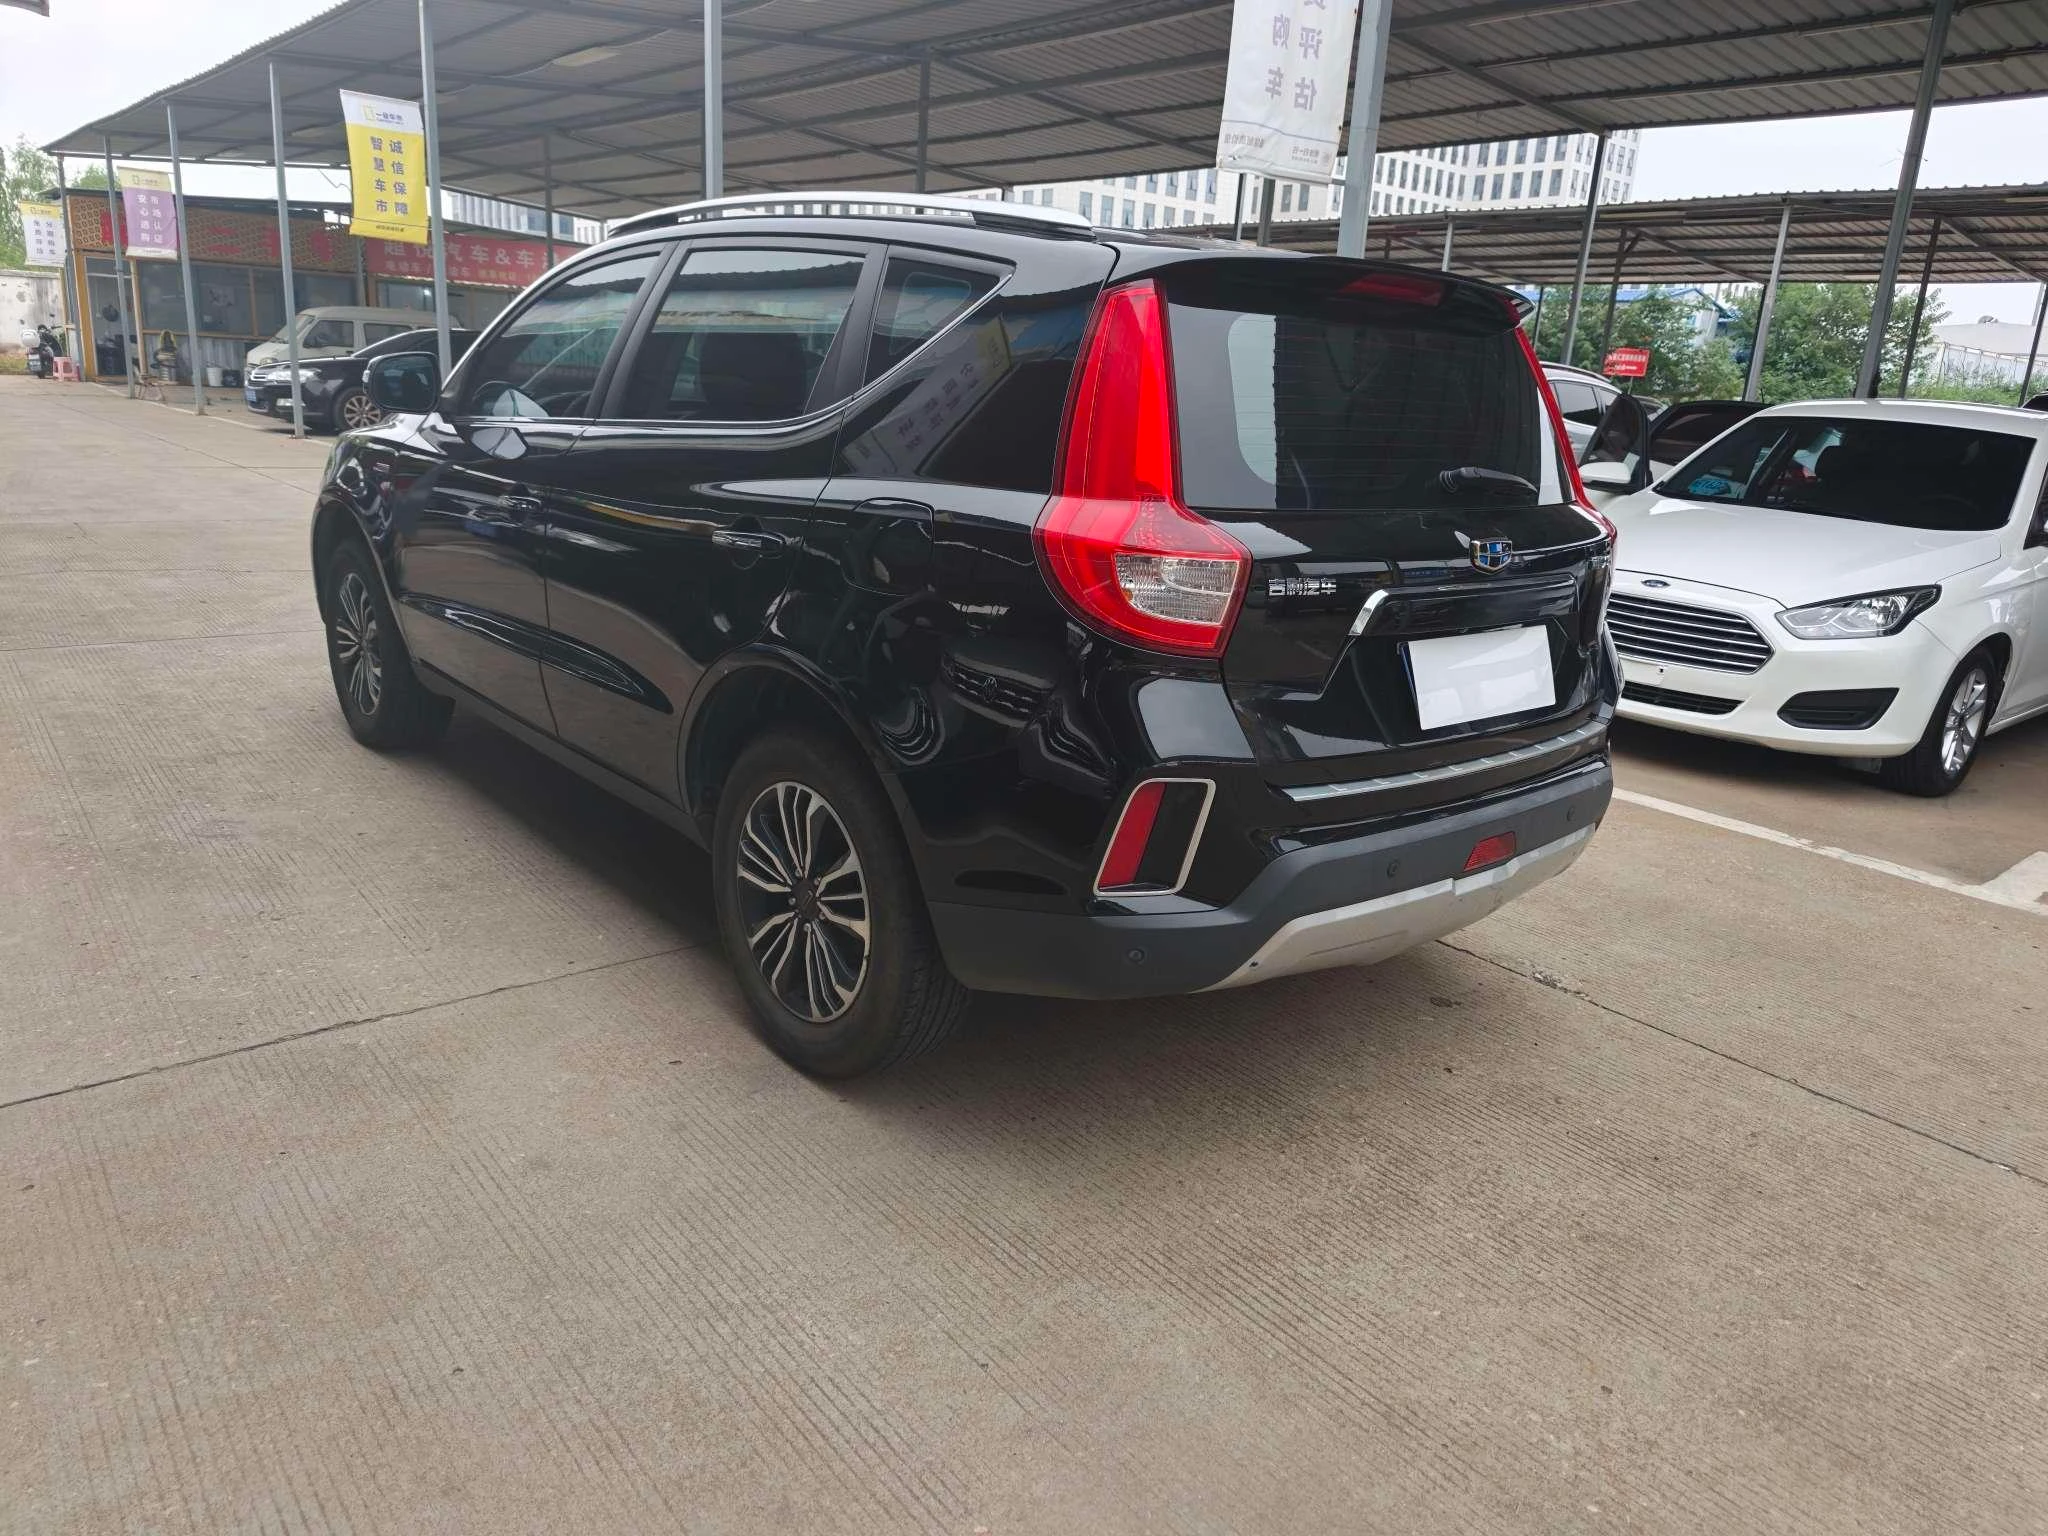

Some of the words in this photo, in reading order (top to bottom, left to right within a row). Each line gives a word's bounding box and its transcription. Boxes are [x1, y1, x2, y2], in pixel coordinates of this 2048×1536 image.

[370, 136, 388, 213] 智慧车市
[389, 139, 409, 215] 诚信保障
